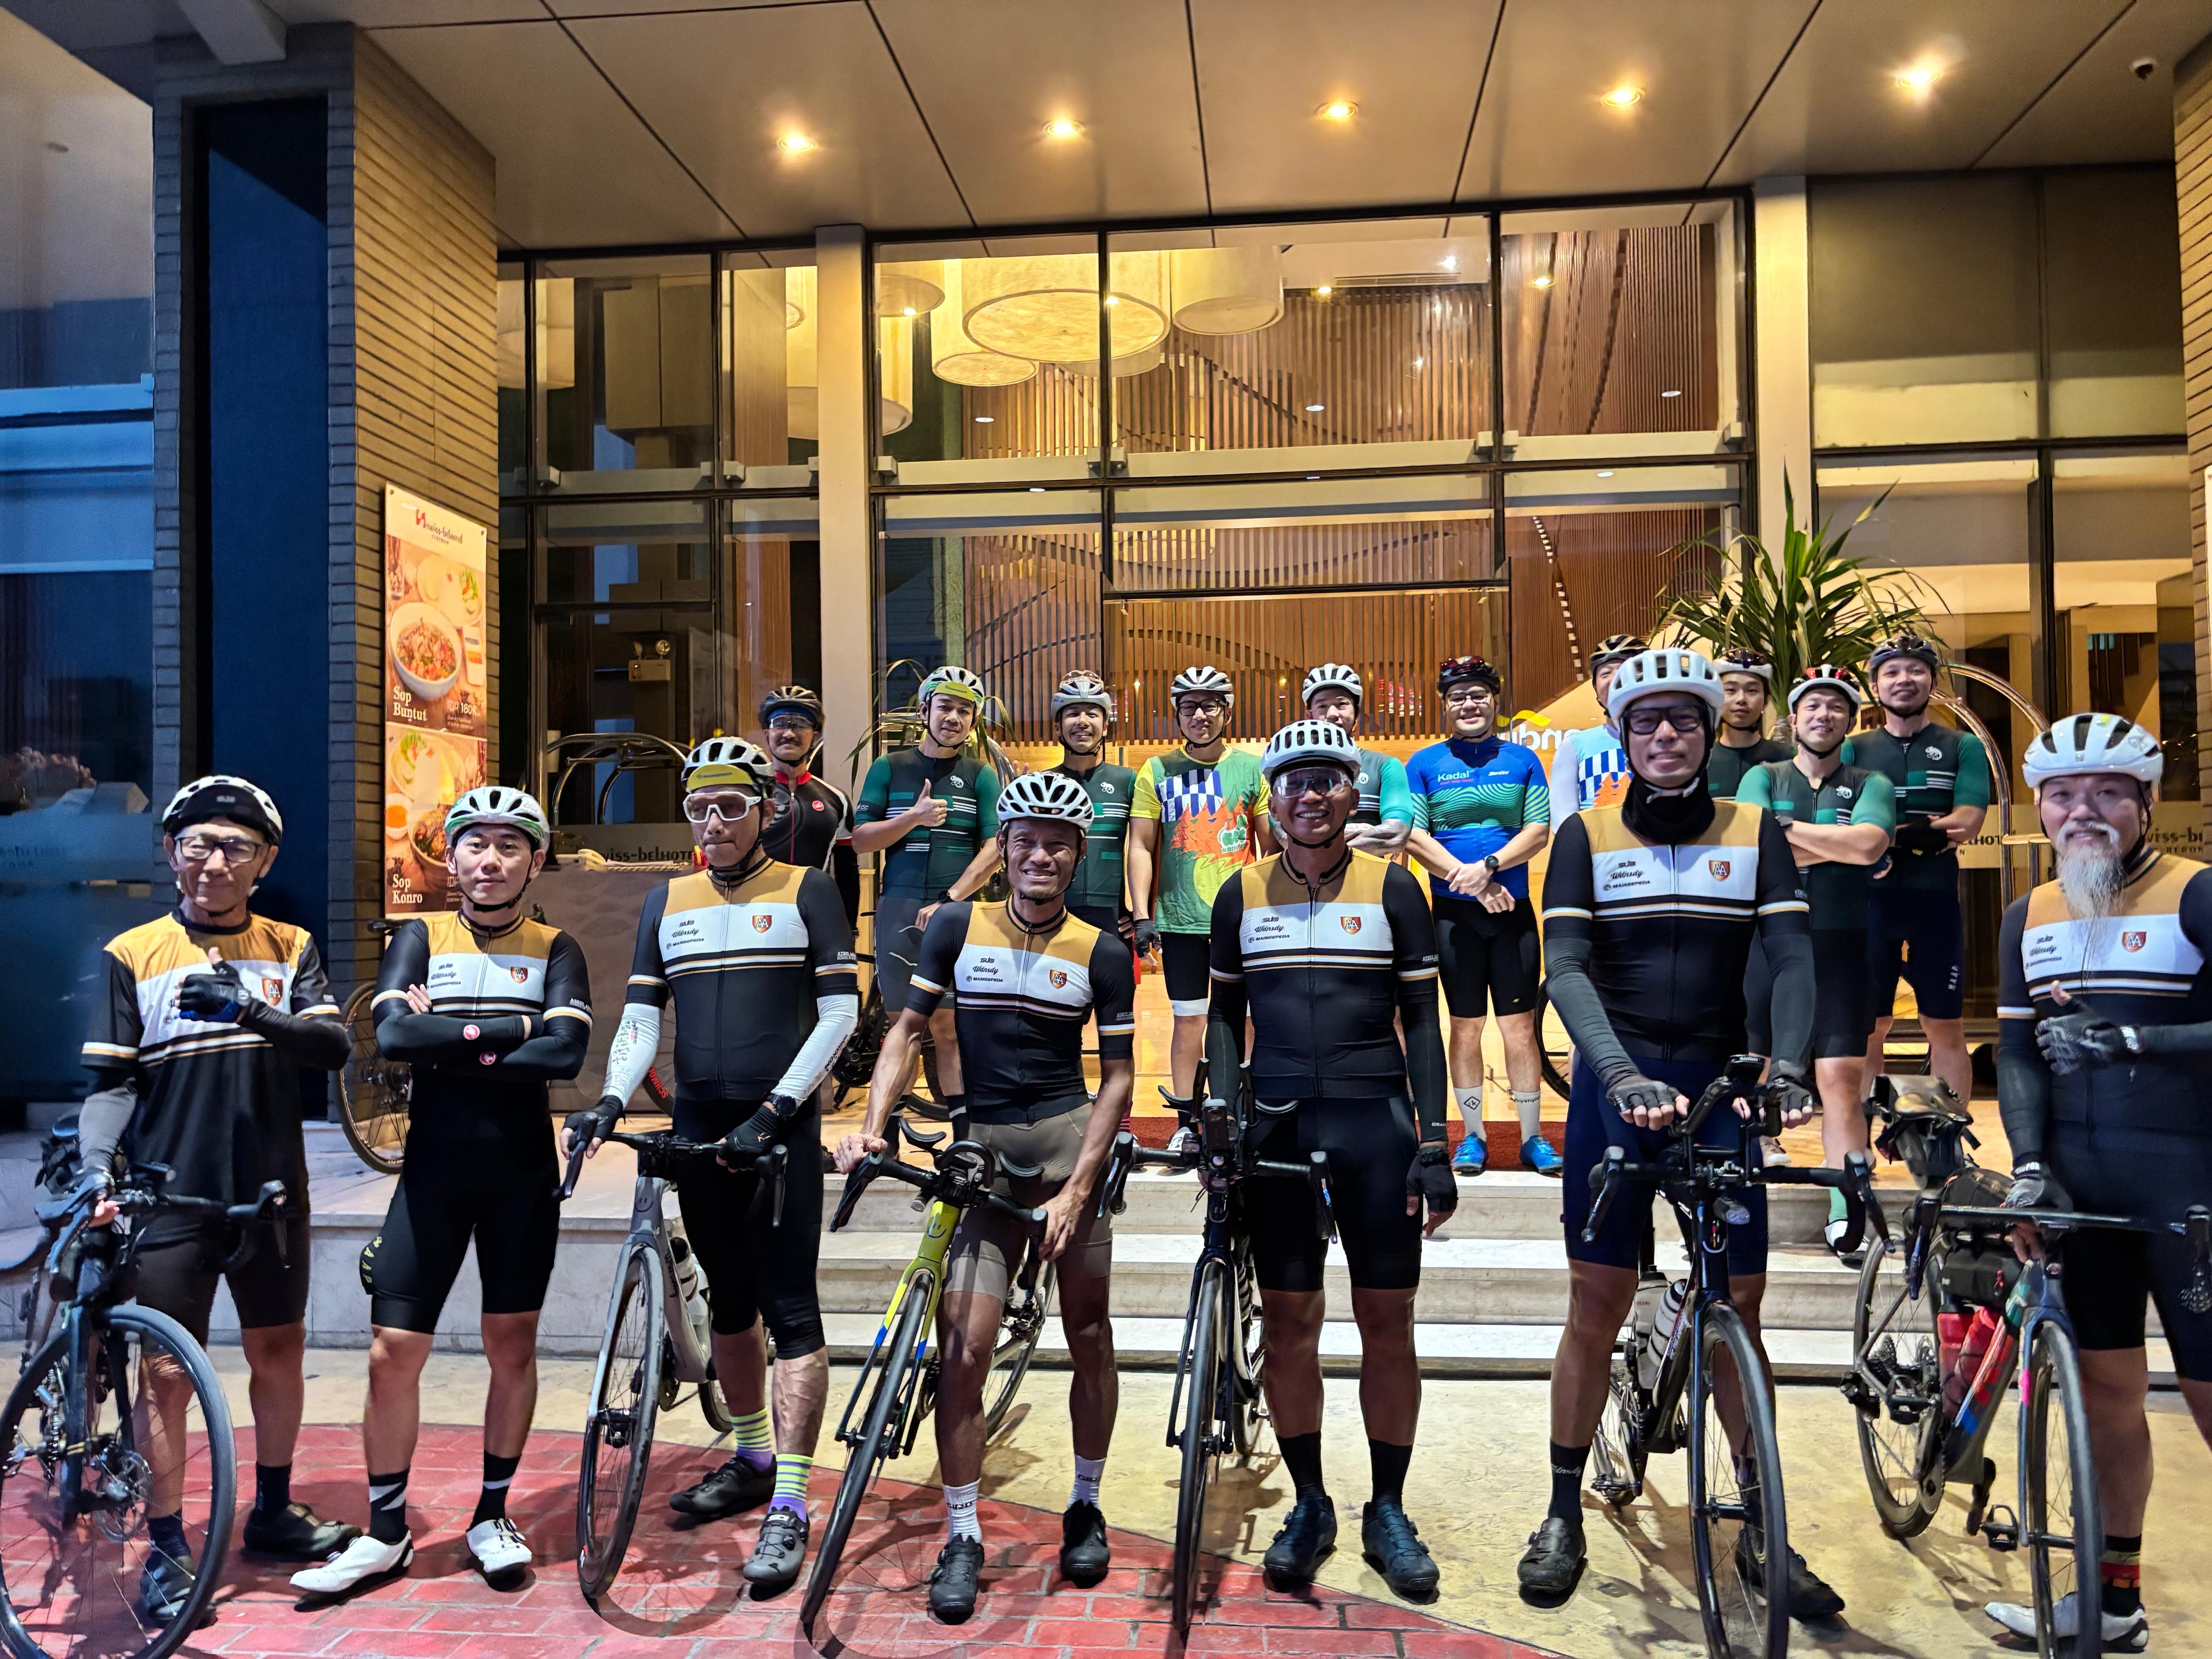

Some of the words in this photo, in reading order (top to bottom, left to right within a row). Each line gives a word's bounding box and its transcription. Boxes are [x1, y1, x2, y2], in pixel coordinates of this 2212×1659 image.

[393, 685, 412, 707] Sop
[393, 702, 428, 722] Buntut
[1437, 770, 1469, 783] Kadal
[392, 874, 411, 893] Sop
[392, 890, 423, 904] Konro
[973, 966, 1000, 975] Wdnsdy
